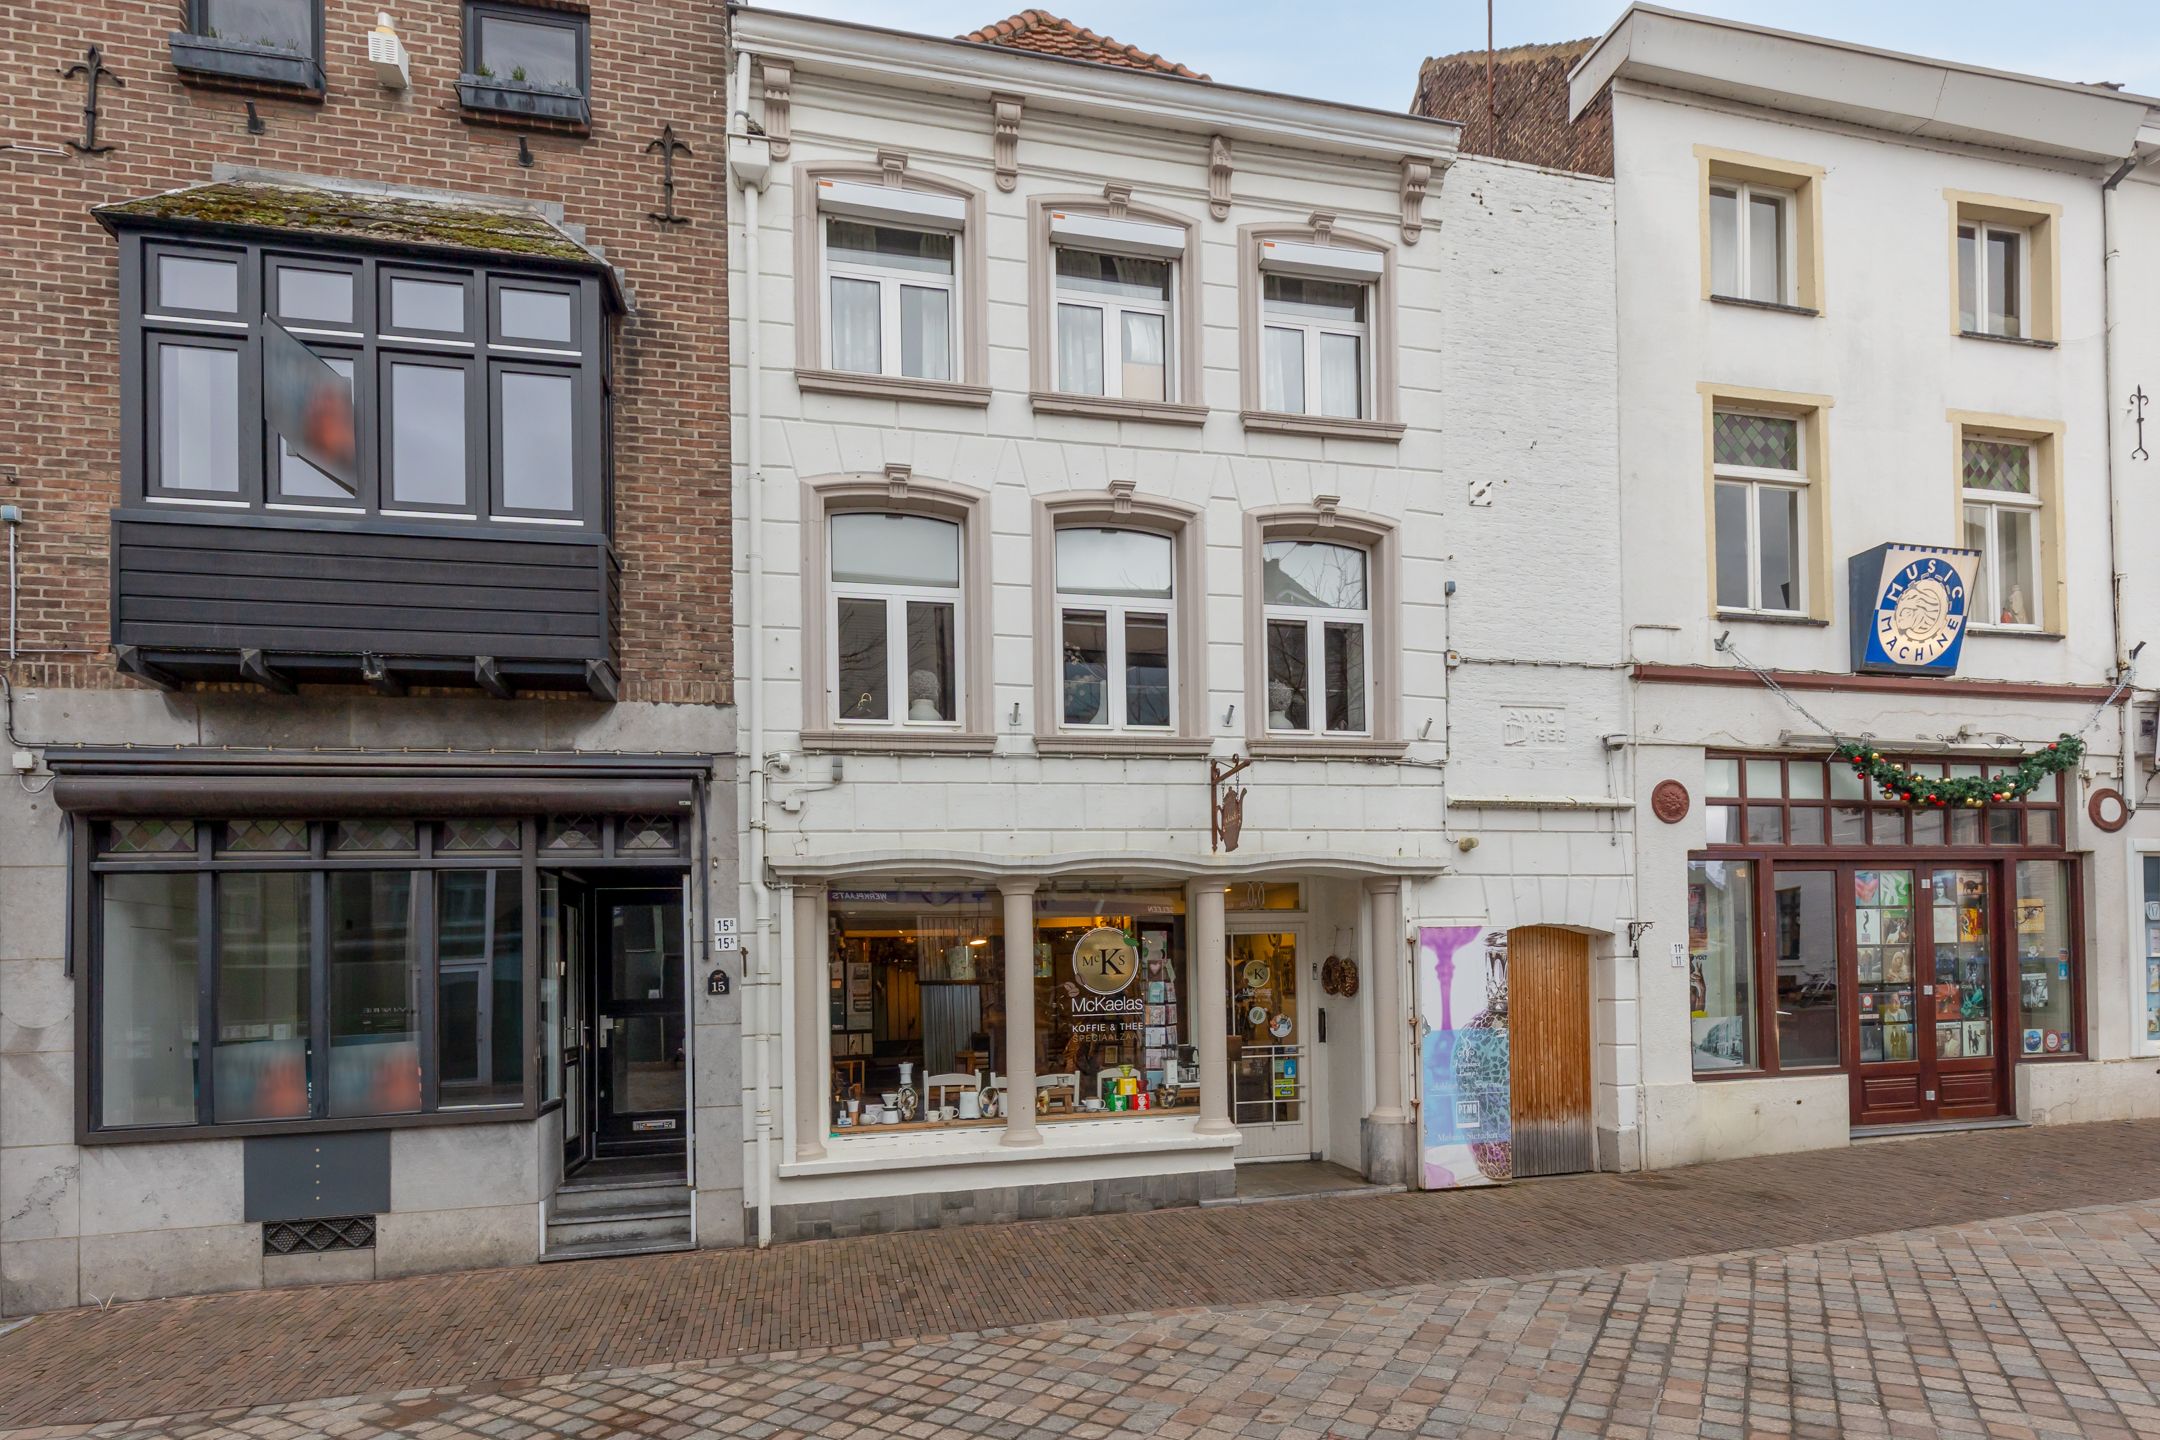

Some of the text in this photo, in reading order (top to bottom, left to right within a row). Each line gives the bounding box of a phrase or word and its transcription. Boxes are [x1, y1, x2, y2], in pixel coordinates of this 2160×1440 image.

[1886, 559, 1963, 603] MUSIC
[1881, 615, 1959, 661] MACHINE
[1507, 711, 1556, 724] ANNO
[717, 937, 735, 949] 15A
[711, 981, 726, 993] 15
[1071, 996, 1144, 1013] McKaelas
[1072, 1022, 1144, 1033] KOFFIE & THEE
